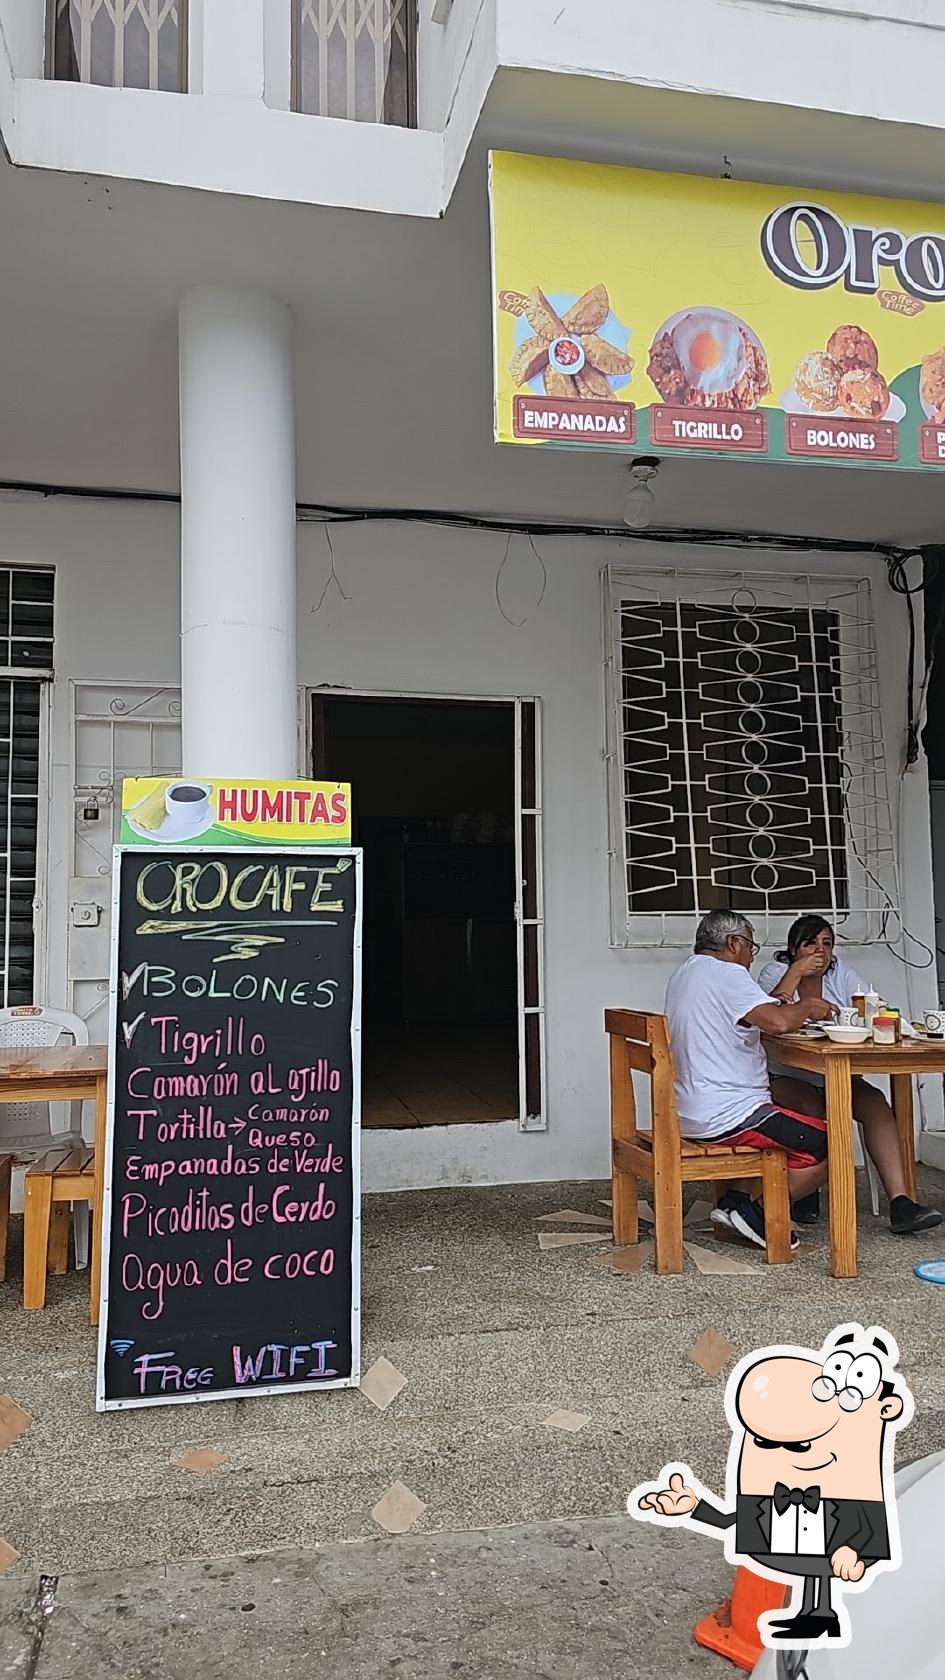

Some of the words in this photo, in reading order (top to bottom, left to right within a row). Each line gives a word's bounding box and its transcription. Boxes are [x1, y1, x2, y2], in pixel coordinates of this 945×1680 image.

[523, 410, 626, 434] EMPANADAS
[672, 419, 743, 441] TIGRILLO
[807, 429, 875, 450] BOLONES
[217, 788, 347, 825] HUMITAS
[150, 1016, 266, 1065] Tigrillo
[127, 1062, 239, 1100] Camarón
[126, 1105, 228, 1143] Tortilla
[247, 1103, 330, 1123] Camarón
[248, 1128, 316, 1148] Queso
[125, 1143, 261, 1186] Empanadas
[294, 1143, 344, 1174] Verde
[271, 1182, 336, 1223] Cerdo
[214, 1238, 253, 1285] de
[264, 1248, 335, 1279] coco
[232, 1340, 338, 1384] WIFI
